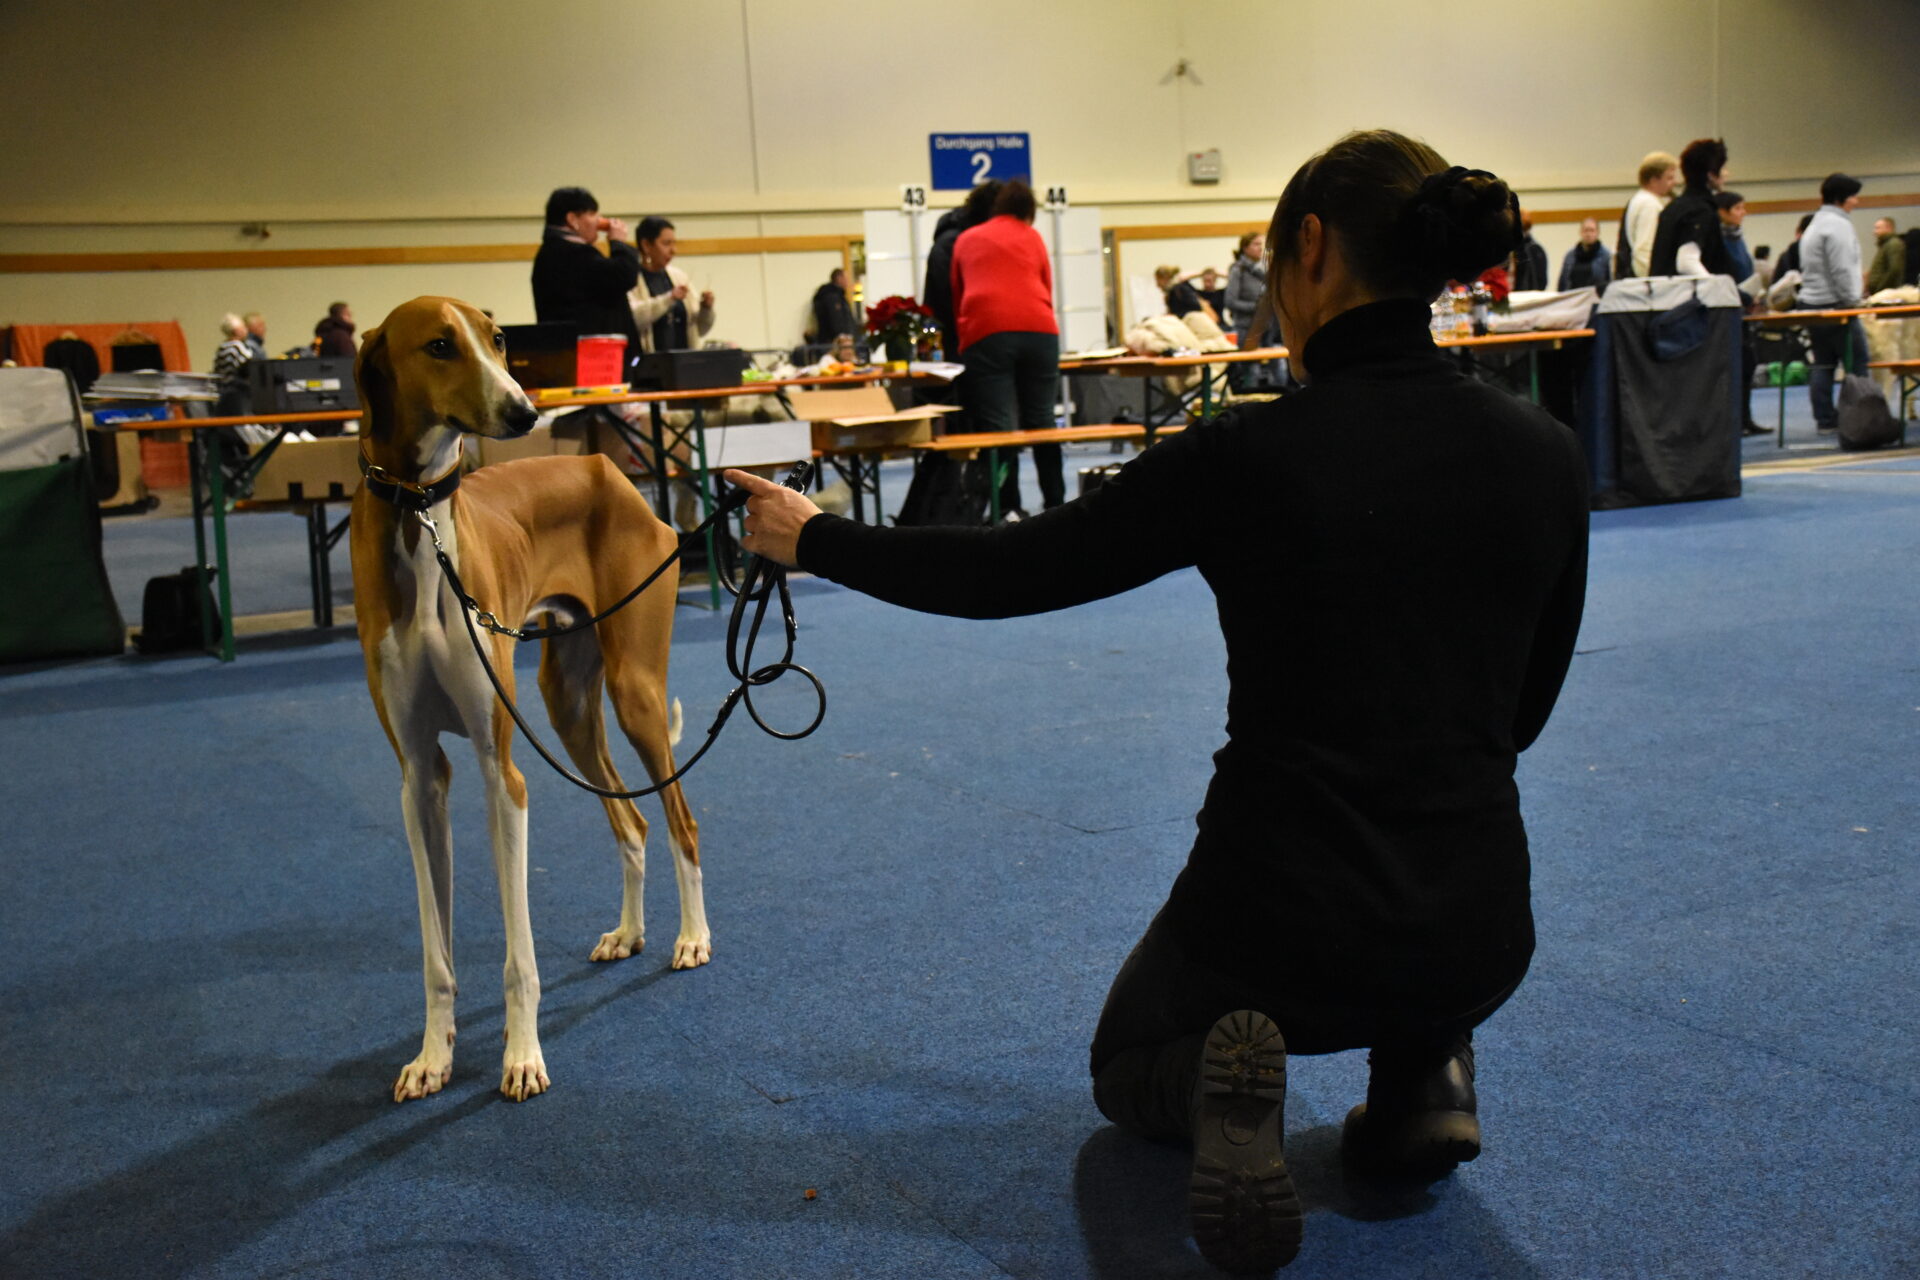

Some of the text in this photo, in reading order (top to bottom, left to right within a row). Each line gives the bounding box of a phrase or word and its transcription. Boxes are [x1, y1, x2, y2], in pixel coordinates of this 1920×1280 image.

[936, 136, 1024, 150] Durchgang Halle
[971, 152, 992, 185] 2
[904, 188, 925, 205] 43
[1046, 188, 1066, 204] 44
